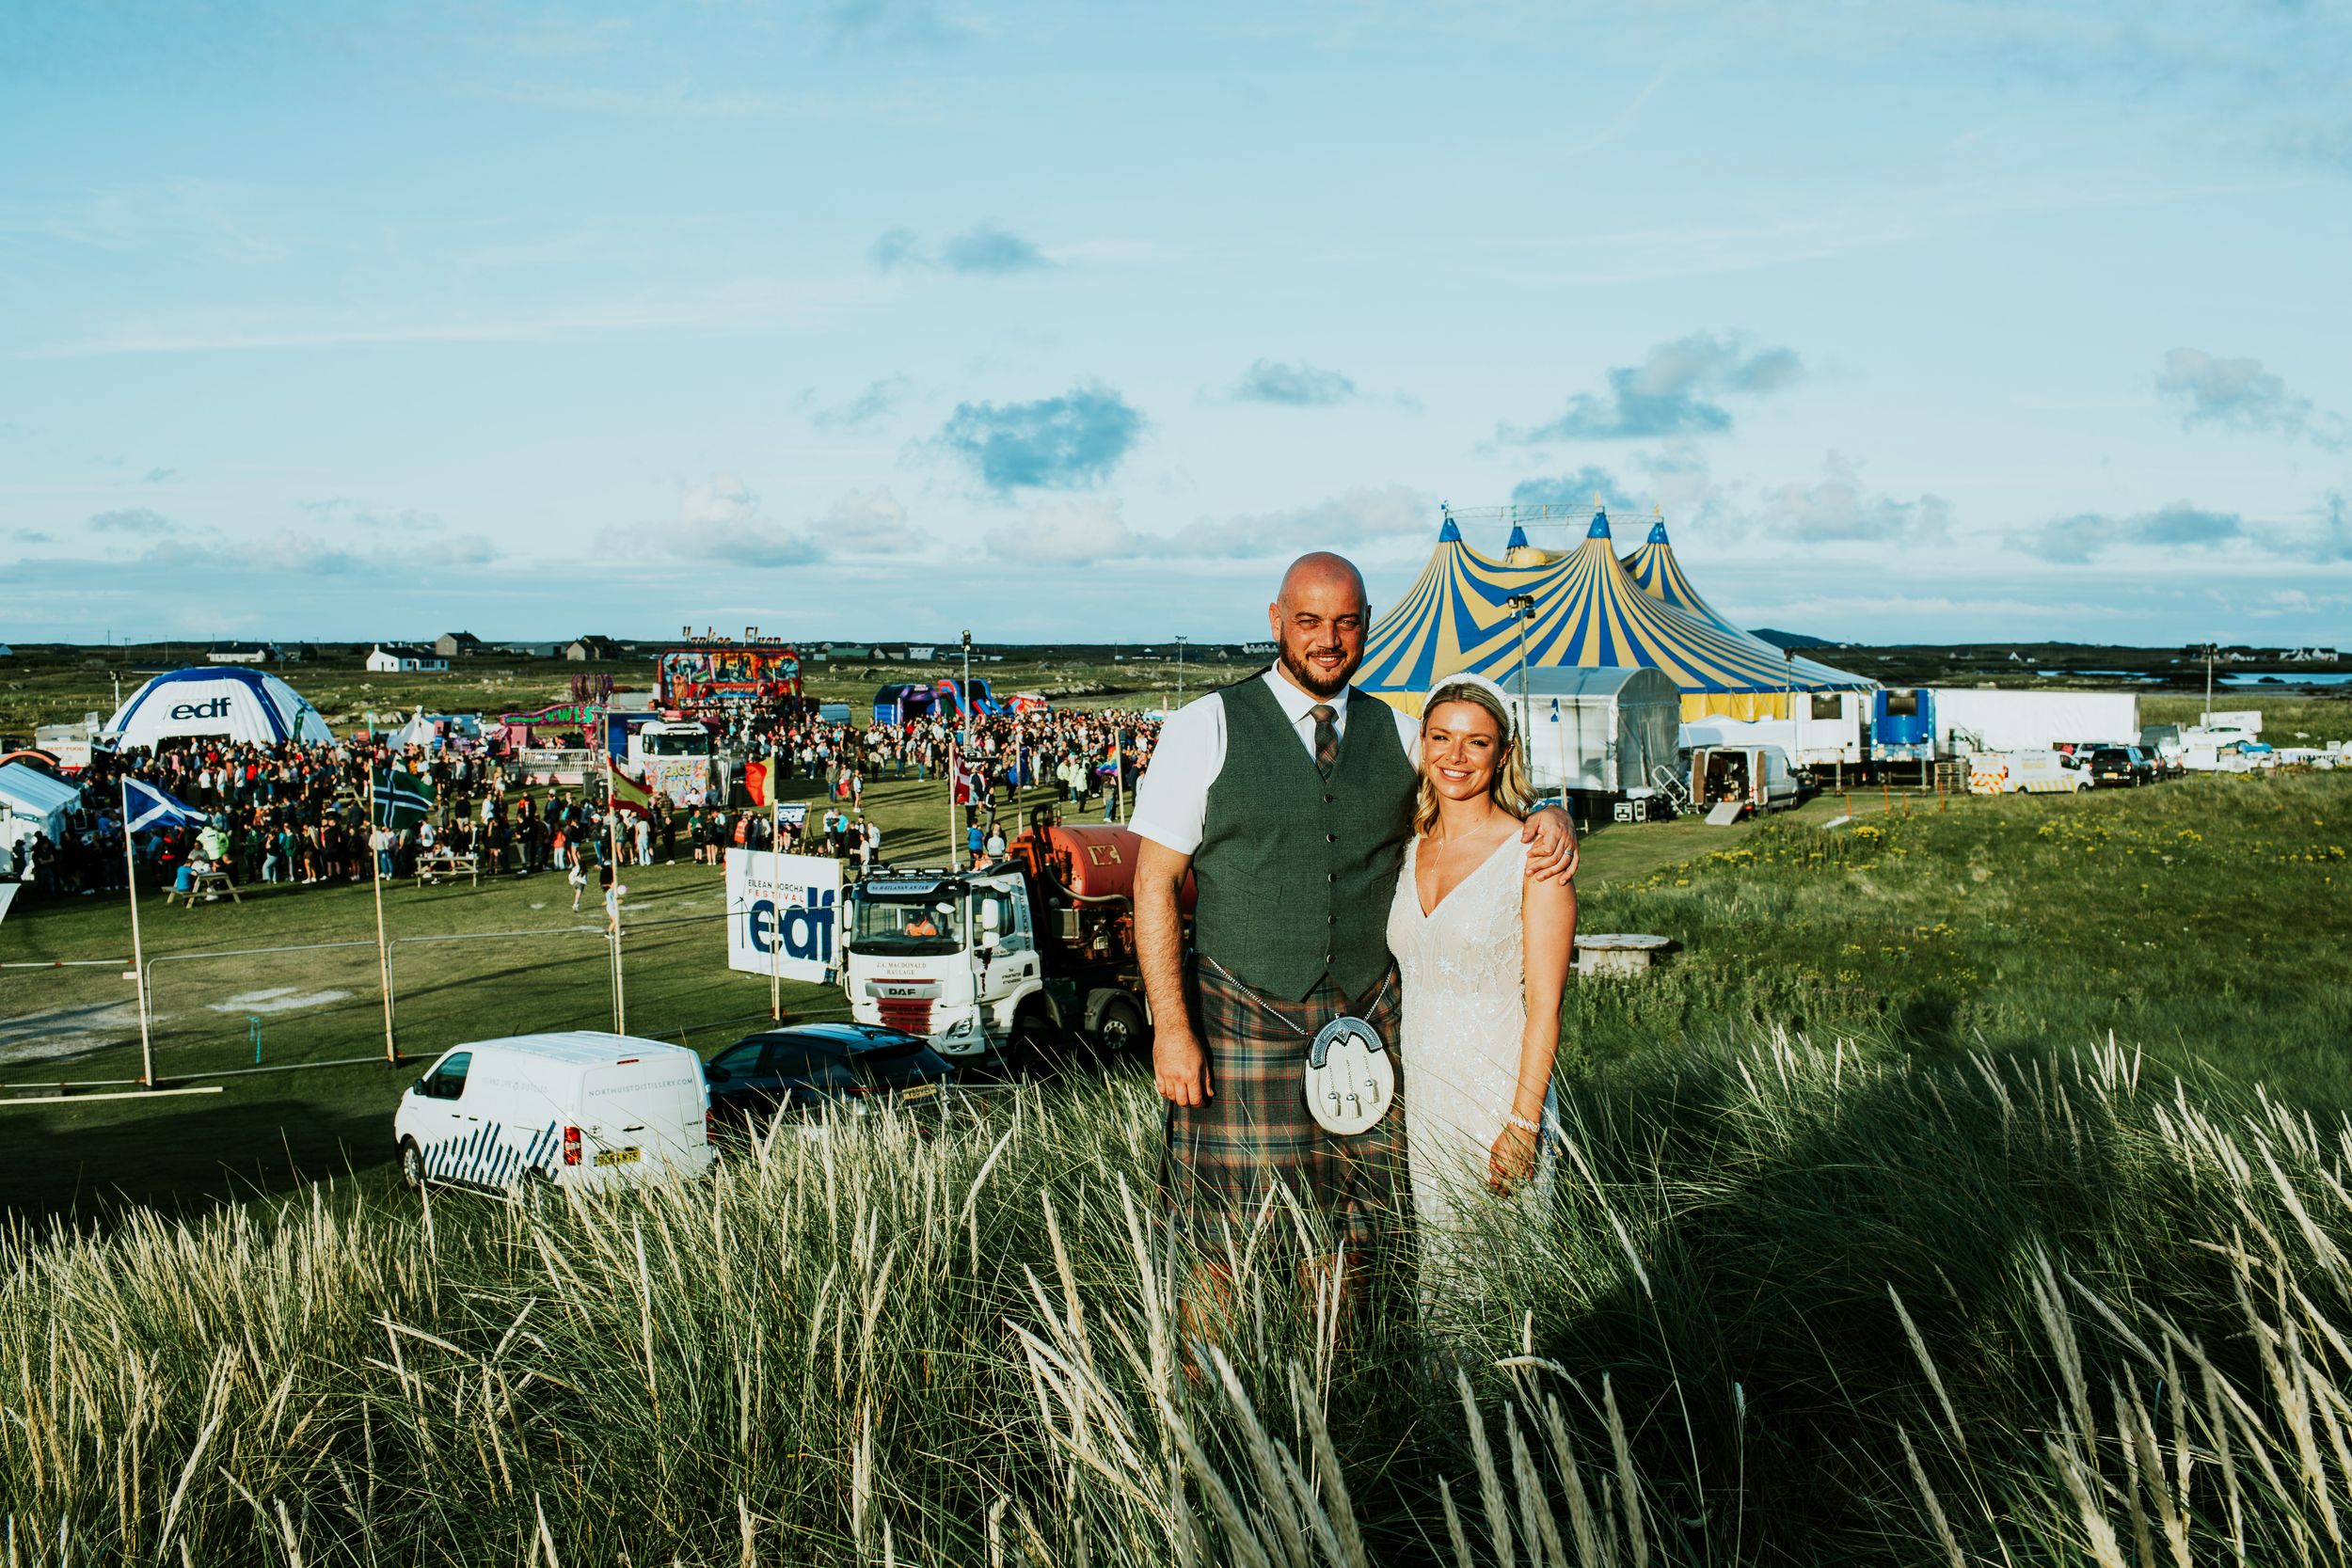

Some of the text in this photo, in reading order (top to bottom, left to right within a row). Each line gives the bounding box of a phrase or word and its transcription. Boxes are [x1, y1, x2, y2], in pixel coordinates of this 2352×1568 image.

[170, 697, 231, 720] edf
[748, 879, 772, 889] EILEAN
[748, 888, 804, 903] FESTIVAL
[749, 886, 835, 962] edf
[888, 988, 915, 996] DAF
[589, 1078, 692, 1097] NORTHUISTDISTILLERY.COM
